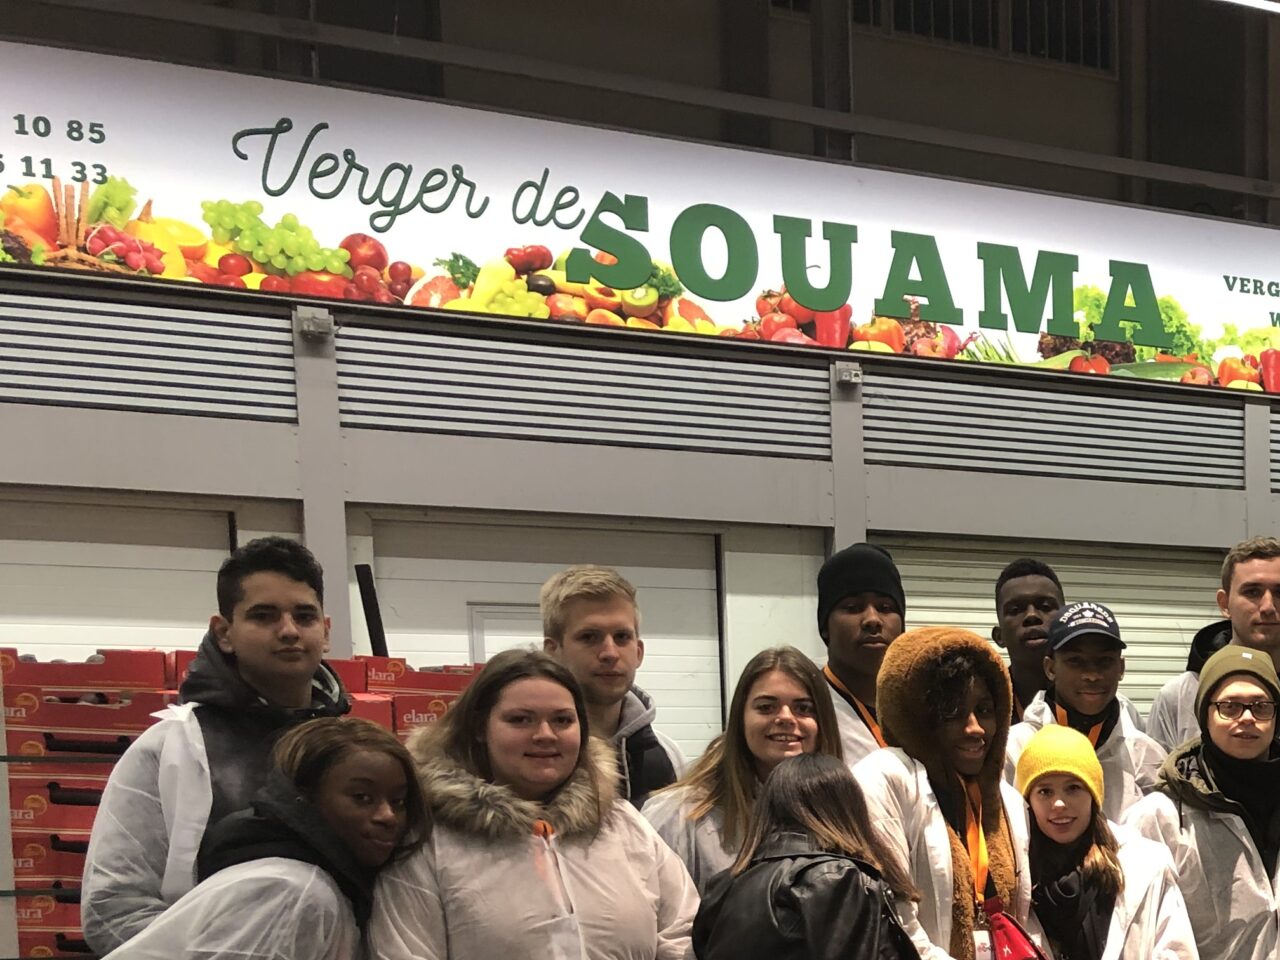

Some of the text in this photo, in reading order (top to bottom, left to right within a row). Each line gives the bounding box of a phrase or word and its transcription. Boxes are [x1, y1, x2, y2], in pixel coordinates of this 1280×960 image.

[13, 114, 106, 144] 10 85
[20, 156, 55, 179] 11
[71, 161, 108, 185] 33
[232, 117, 585, 232] Verger de
[565, 190, 1174, 349] SOUAMA
[403, 709, 437, 723] elara
